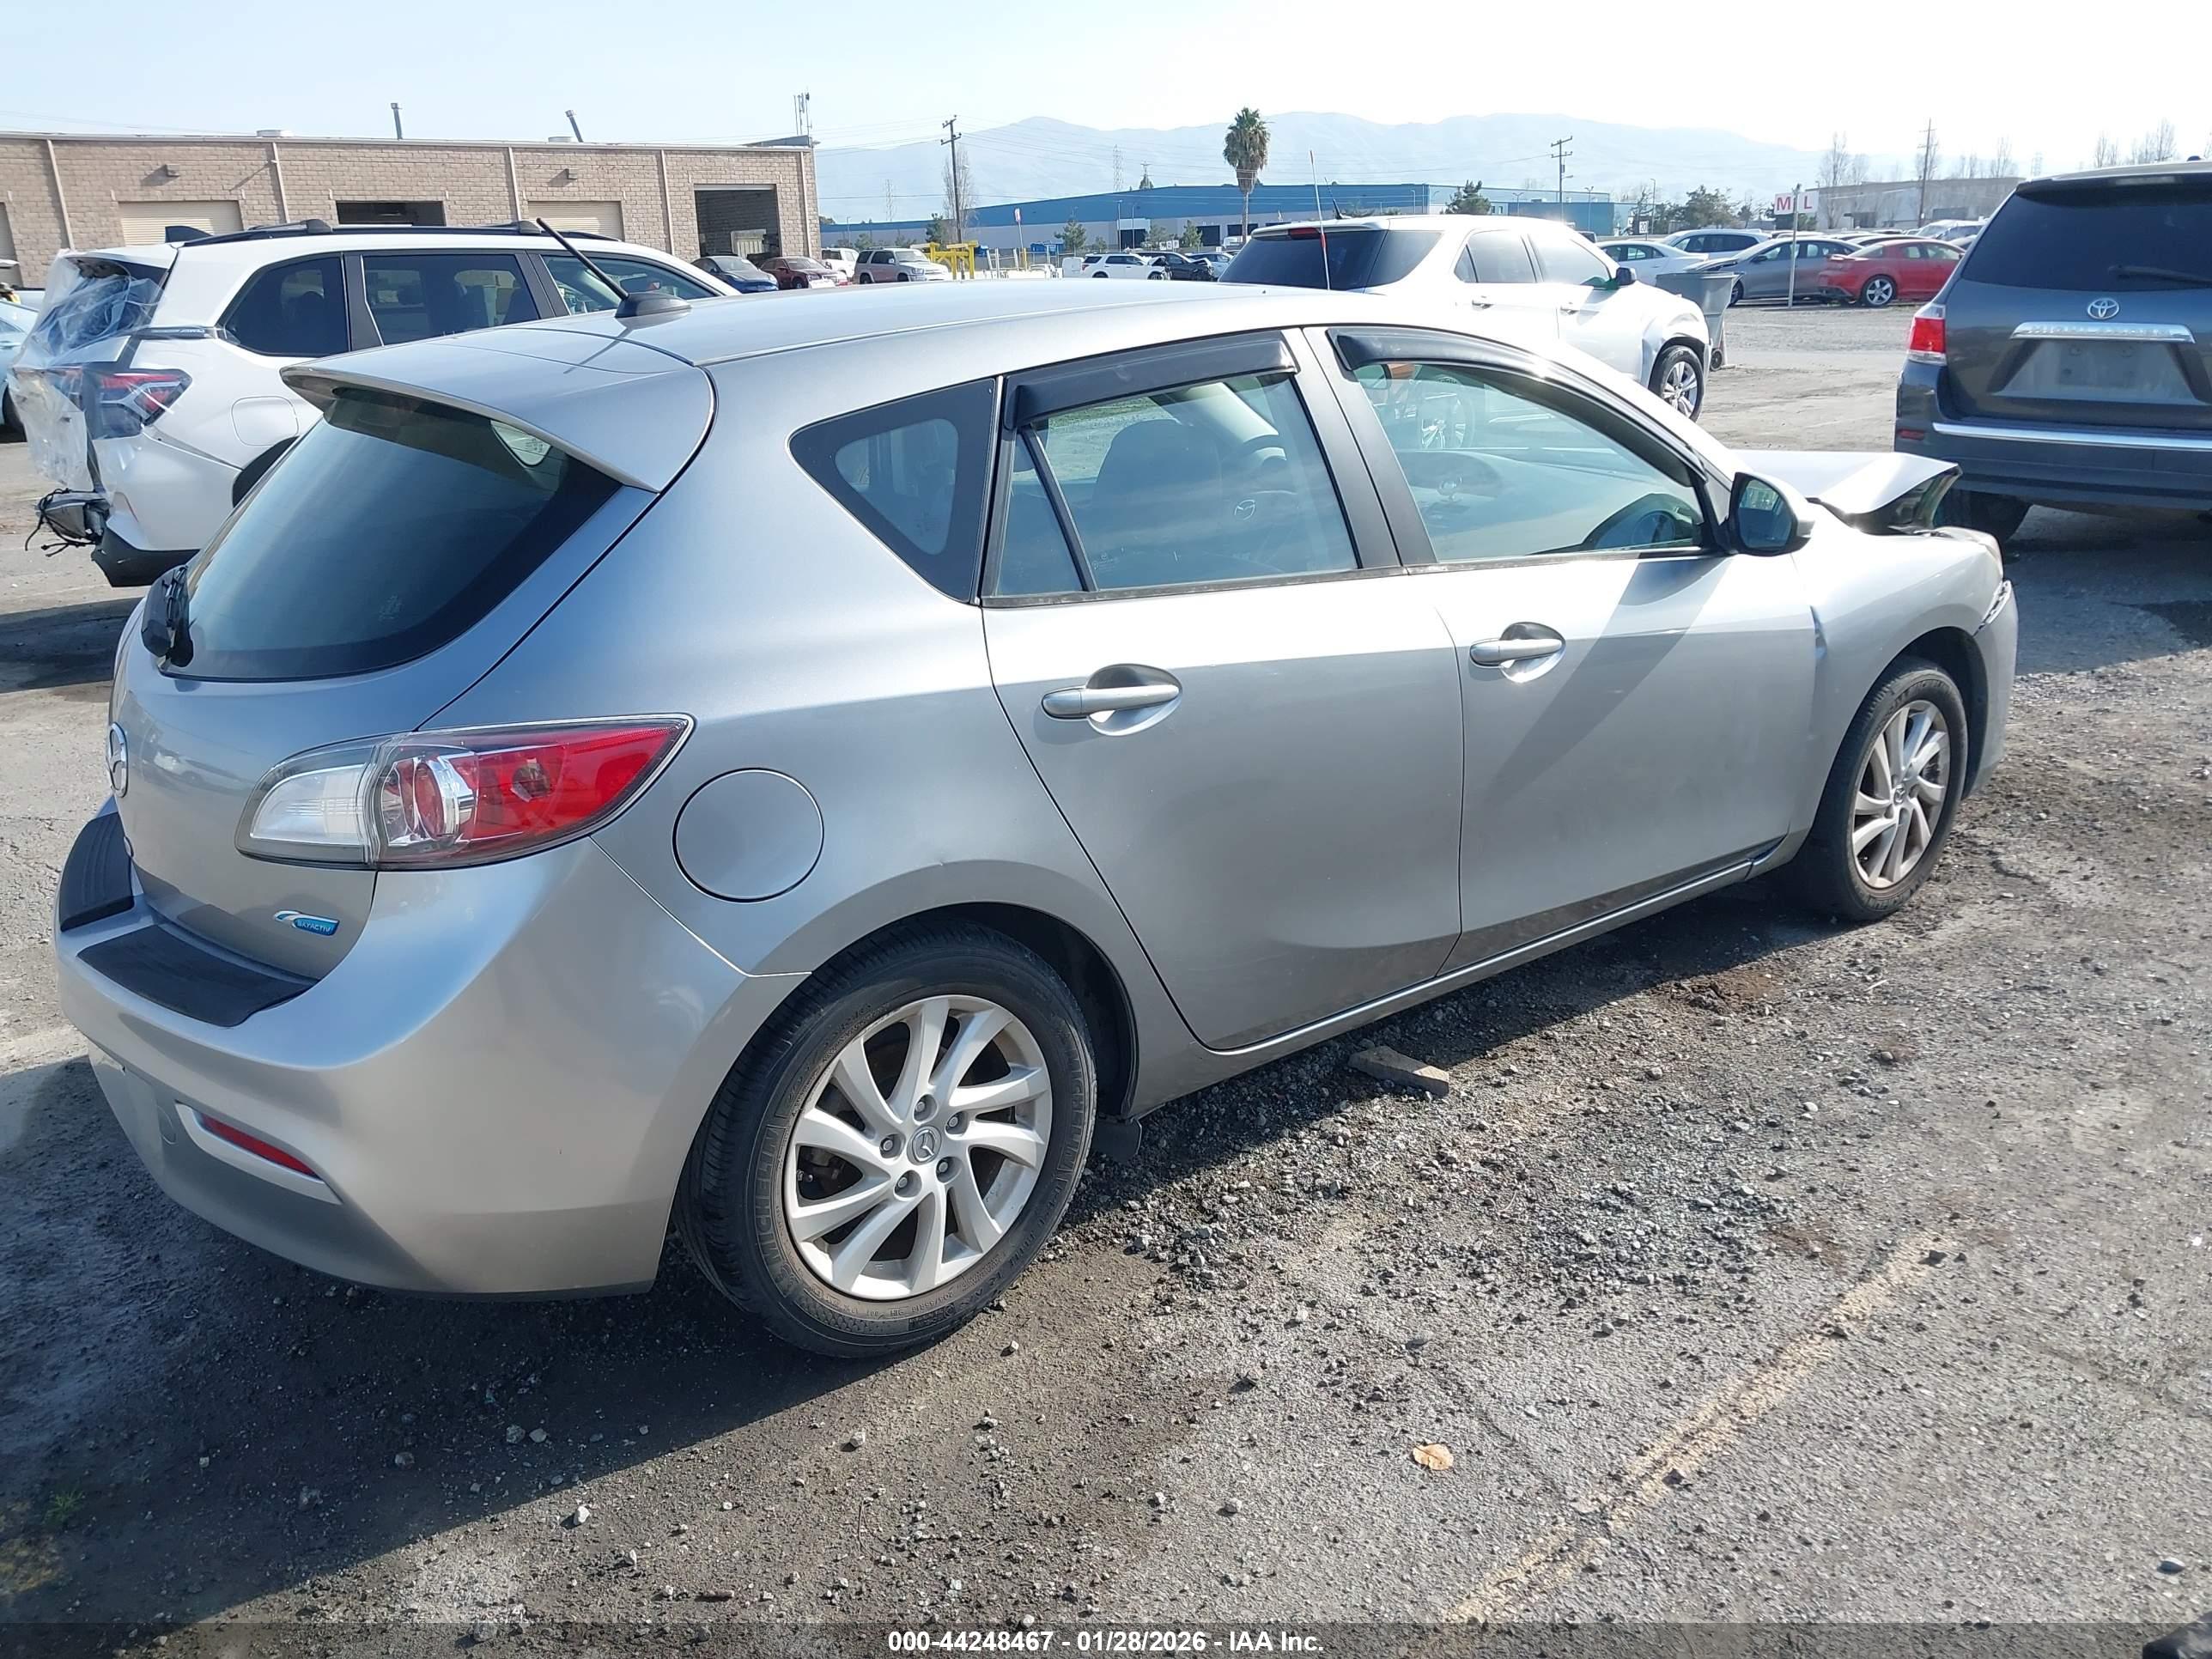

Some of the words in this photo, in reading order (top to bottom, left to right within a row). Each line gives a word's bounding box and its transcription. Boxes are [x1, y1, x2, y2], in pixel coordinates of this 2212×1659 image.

[1777, 196, 1791, 211] M
[1803, 195, 1813, 210] L
[297, 920, 331, 932] SKYACTIV
[754, 1127, 781, 1264] MICHELIN
